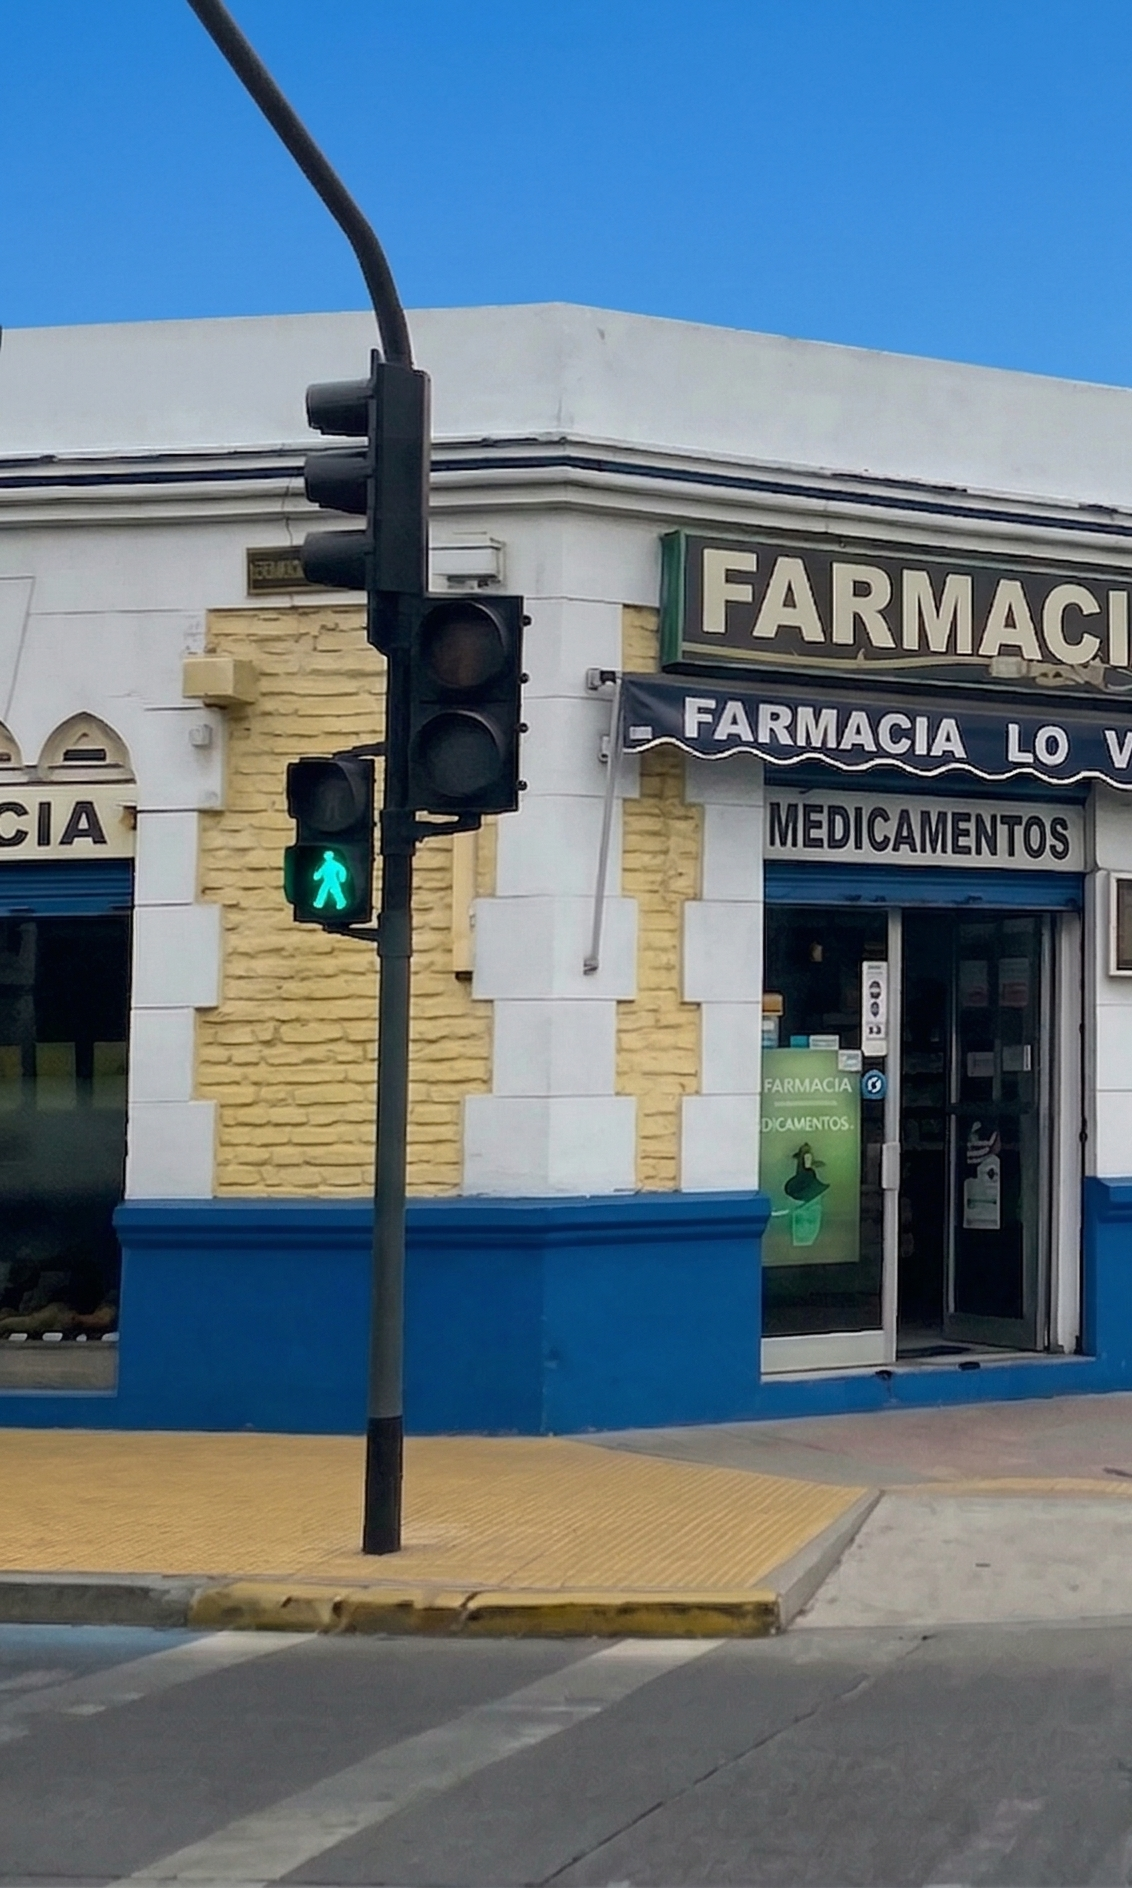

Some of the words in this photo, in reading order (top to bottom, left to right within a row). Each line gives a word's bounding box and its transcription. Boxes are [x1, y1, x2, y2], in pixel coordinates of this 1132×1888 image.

[684, 697, 966, 760] FARMACIA
[1007, 722, 1070, 767] LO
[0, 801, 108, 847] CIA
[769, 802, 1070, 860] MEDICAMENTOS
[763, 1077, 853, 1094] FARMACIA
